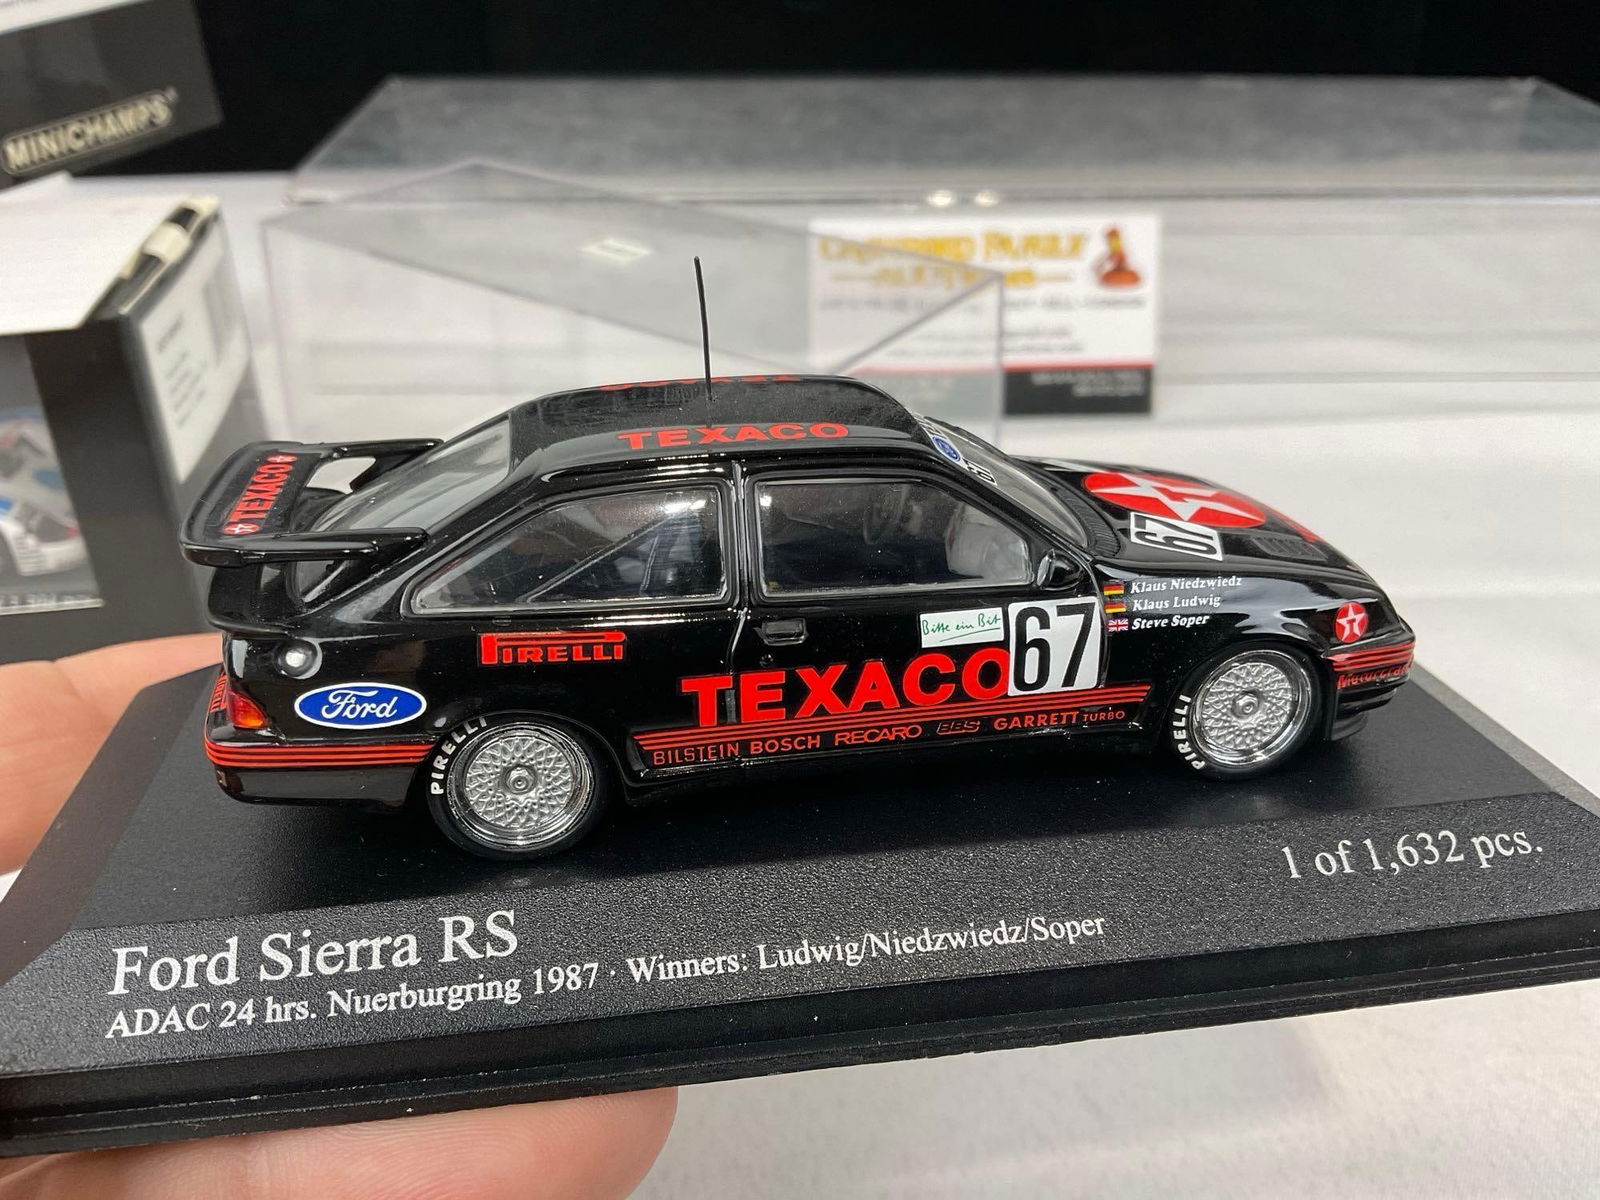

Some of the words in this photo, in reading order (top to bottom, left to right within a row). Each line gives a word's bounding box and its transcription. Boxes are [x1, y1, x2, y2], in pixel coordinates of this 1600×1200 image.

[5, 93, 172, 171] MINICHAMPS
[617, 422, 849, 450] TEXACO
[229, 462, 294, 520] TEXACO
[1134, 514, 1218, 556] 67
[1130, 581, 1167, 594] Klaus
[1170, 576, 1243, 590] Niedzwiedz
[1132, 599, 1169, 612] Klaus
[1172, 595, 1222, 608] Ludwig
[480, 631, 626, 665] PIRELLI
[922, 620, 951, 635] Bitte
[955, 620, 974, 631] ein
[978, 613, 1001, 627] Bit
[1014, 603, 1098, 692] 67
[1131, 618, 1168, 631] Steve
[1170, 615, 1210, 628] Soper
[321, 690, 398, 718] Ford
[681, 648, 1009, 728] TEXACO
[430, 714, 488, 796] PIRELLI
[653, 742, 740, 766] BILSTEIN
[750, 735, 821, 755] BOSCH
[834, 724, 923, 746] RECARO
[993, 711, 1079, 731] GARRETT
[1082, 710, 1126, 723] TURBO
[1172, 694, 1206, 771] PIRELLI
[1281, 846, 1302, 879] 1
[1314, 839, 1355, 876] of
[1362, 830, 1464, 875] 1,632
[1470, 831, 1543, 869] pcs.
[105, 1002, 212, 1039] ADAC
[217, 1001, 258, 1028] 24
[264, 997, 317, 1024] hrs.
[326, 974, 522, 1018] Nuerburgring
[532, 962, 599, 992] 1987
[625, 949, 749, 983] Winners:
[756, 914, 1107, 970] Ludwig/Niedzwiedz/Soper
[106, 936, 239, 996] Ford
[259, 928, 421, 982] Sierra
[437, 909, 519, 963] RS
